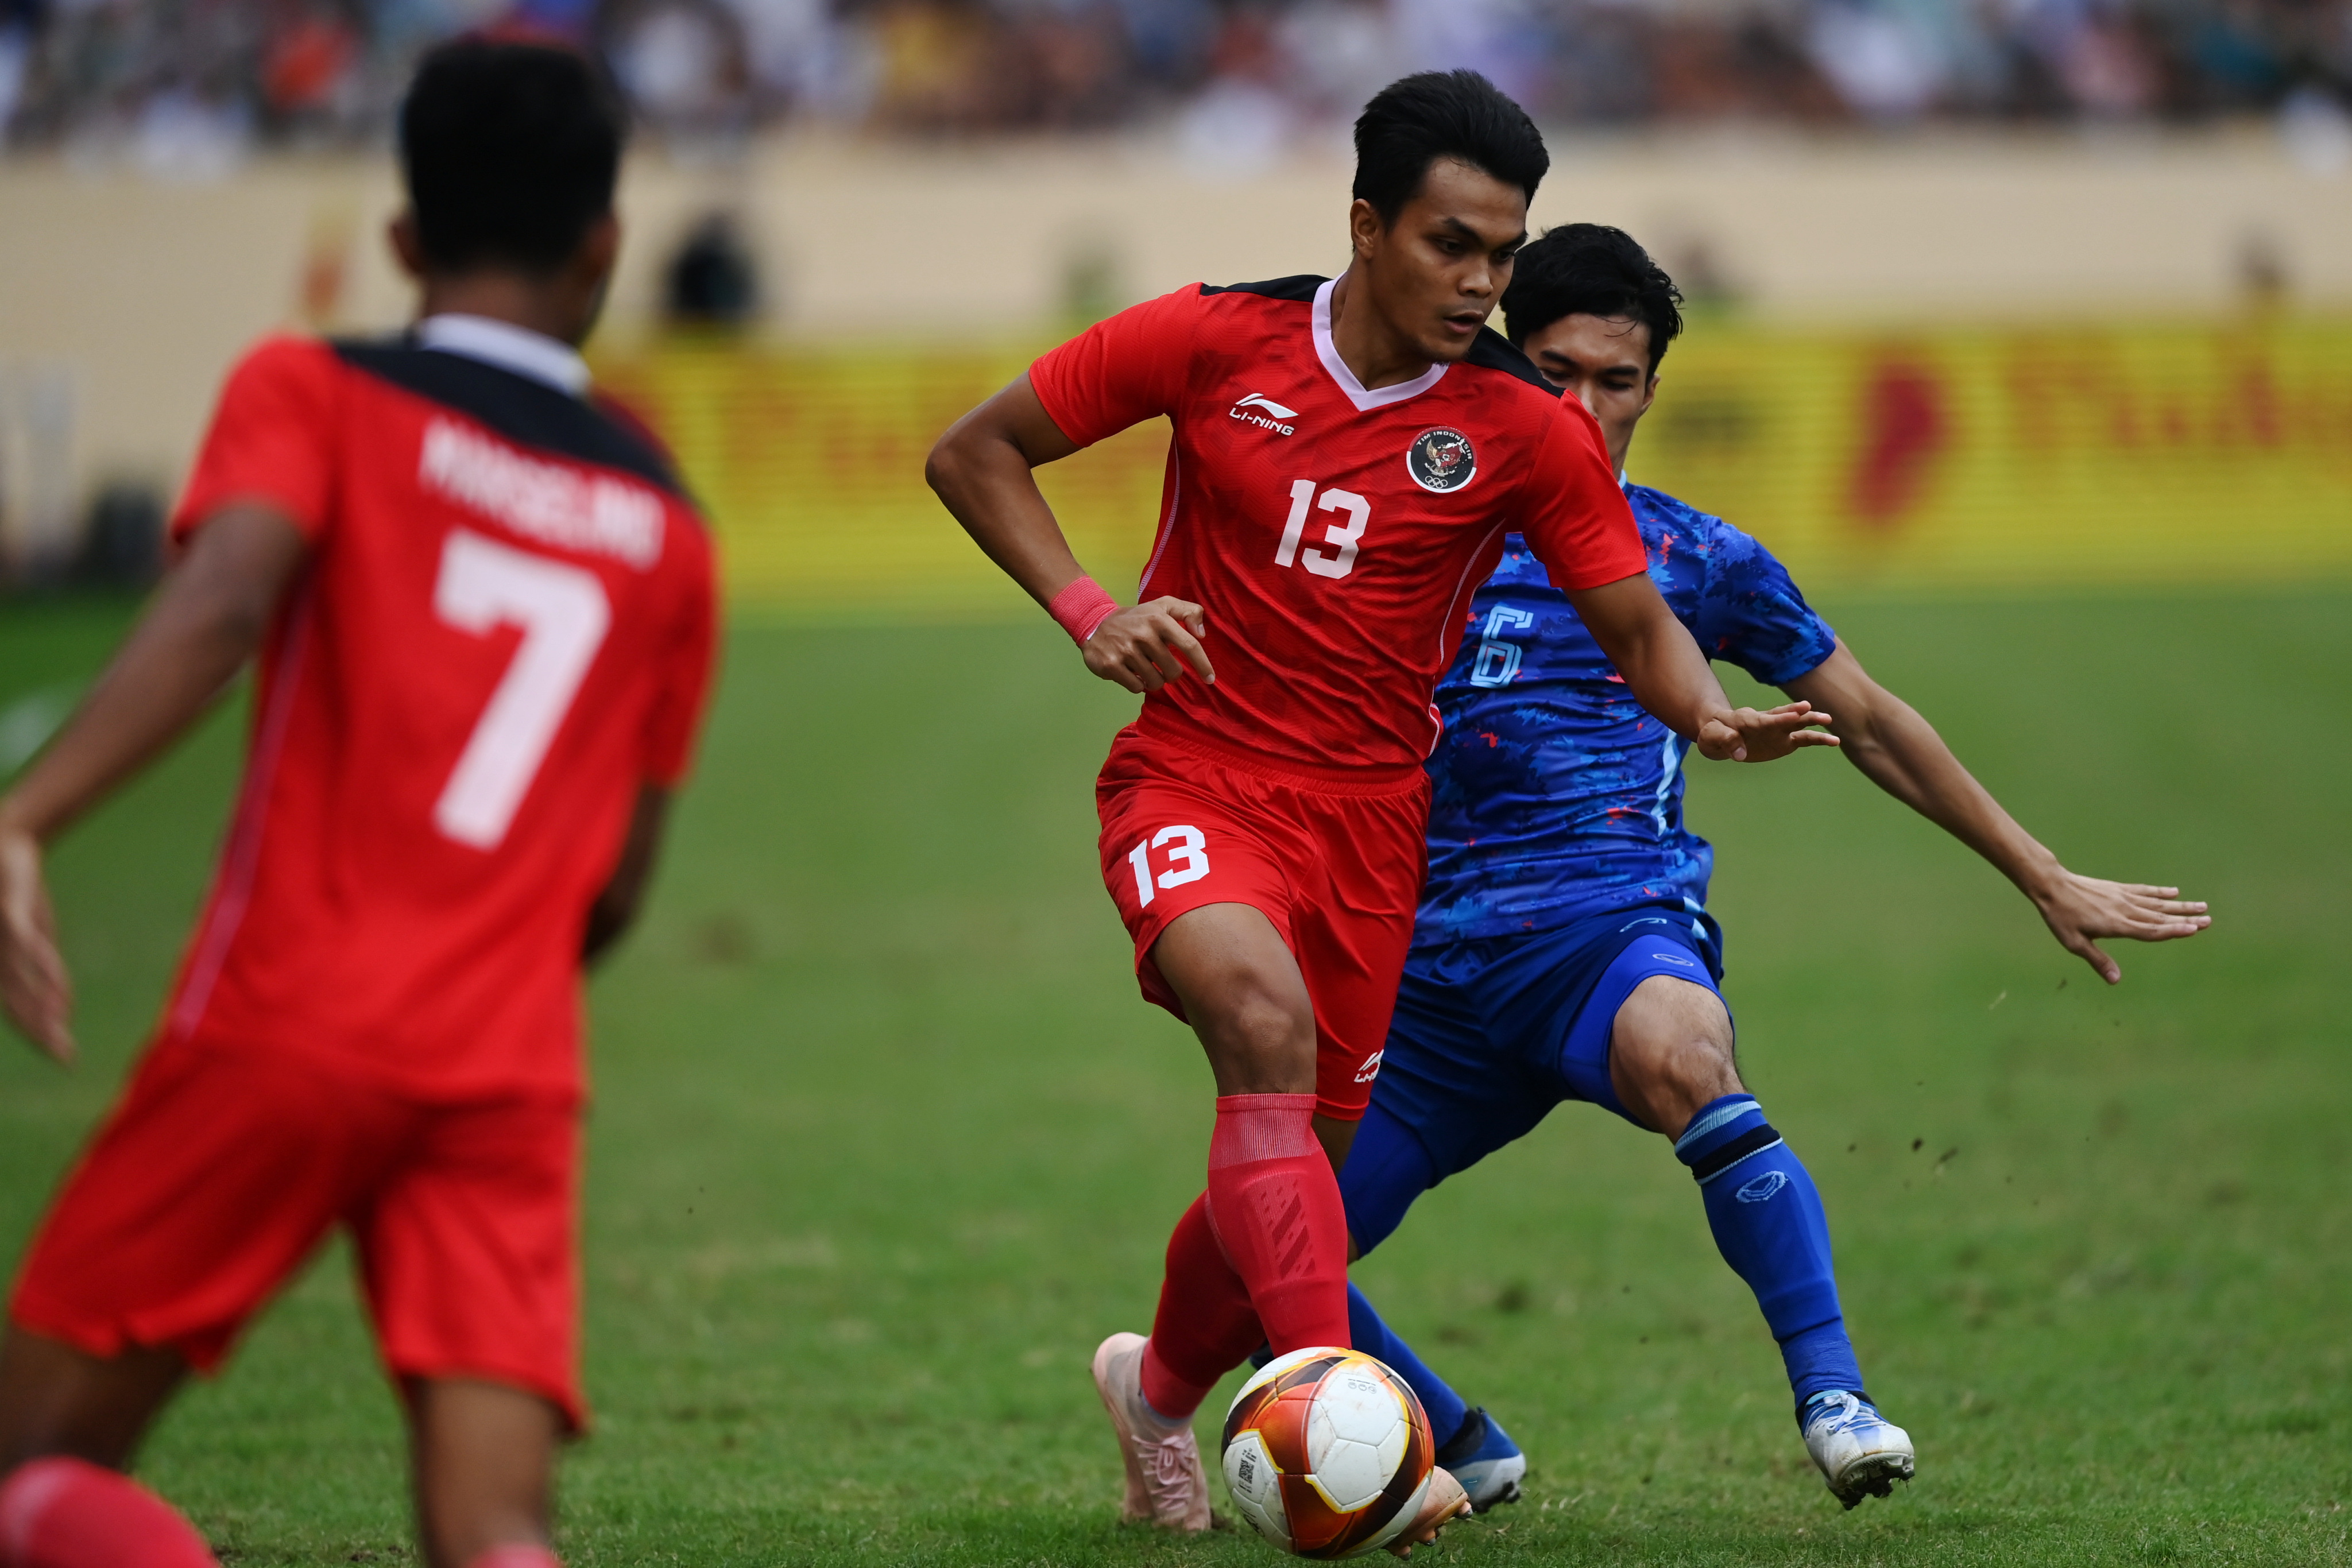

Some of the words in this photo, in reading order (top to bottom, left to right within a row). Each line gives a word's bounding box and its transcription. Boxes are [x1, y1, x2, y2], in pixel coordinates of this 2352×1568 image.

[1229, 407, 1295, 436] LI-NING
[1417, 433, 1431, 446] TIM
[1433, 431, 1472, 459] INDONSIA
[1274, 479, 1371, 579] 13
[1470, 606, 1534, 688] 6
[435, 529, 612, 850] 7
[1129, 825, 1210, 909] 13
